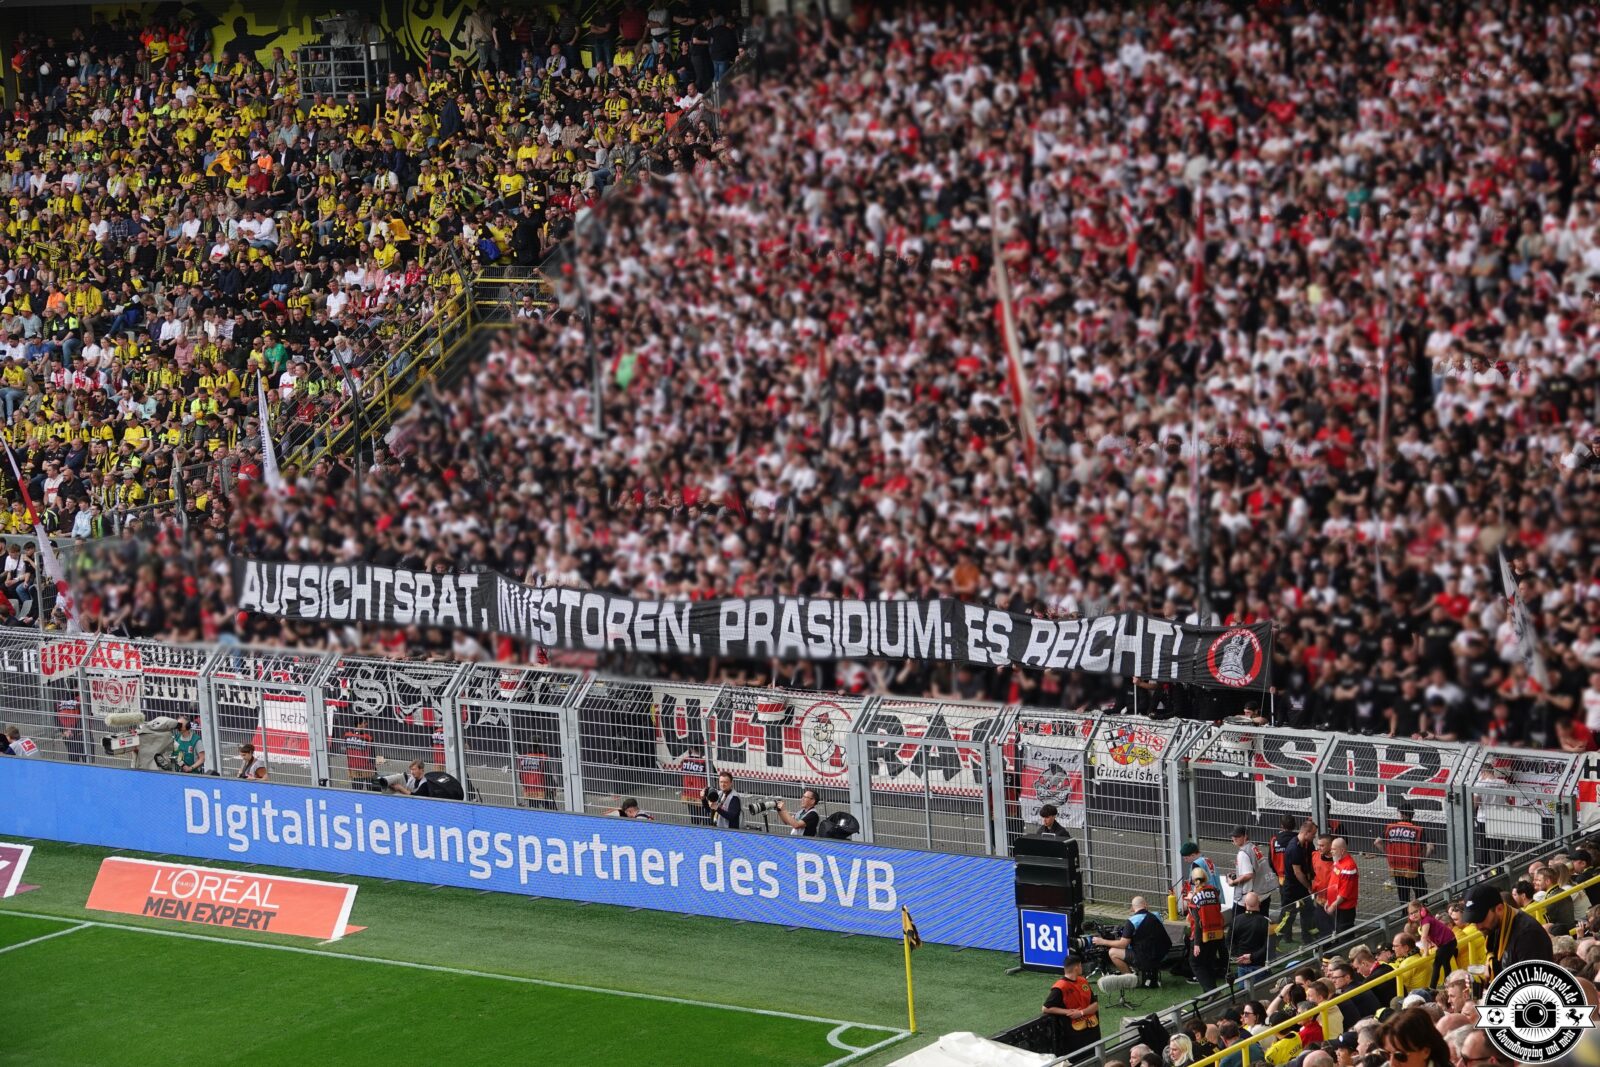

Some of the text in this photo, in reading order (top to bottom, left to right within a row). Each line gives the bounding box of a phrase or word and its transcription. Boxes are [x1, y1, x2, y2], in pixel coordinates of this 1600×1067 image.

[239, 561, 488, 631] AUFSICHTSRAT,
[497, 576, 701, 656] INVESTOREN,
[720, 597, 953, 660] PRÄSIDIUM:
[964, 604, 1014, 666] ES
[1021, 611, 1184, 680] REICHT!
[184, 788, 898, 912] Digitalisierungspartner des BVB
[1389, 827, 1416, 839] atlas
[150, 869, 280, 909] L'ORÉAL
[143, 896, 277, 931] MEN EXPERT
[1026, 922, 1063, 953] 1&1
